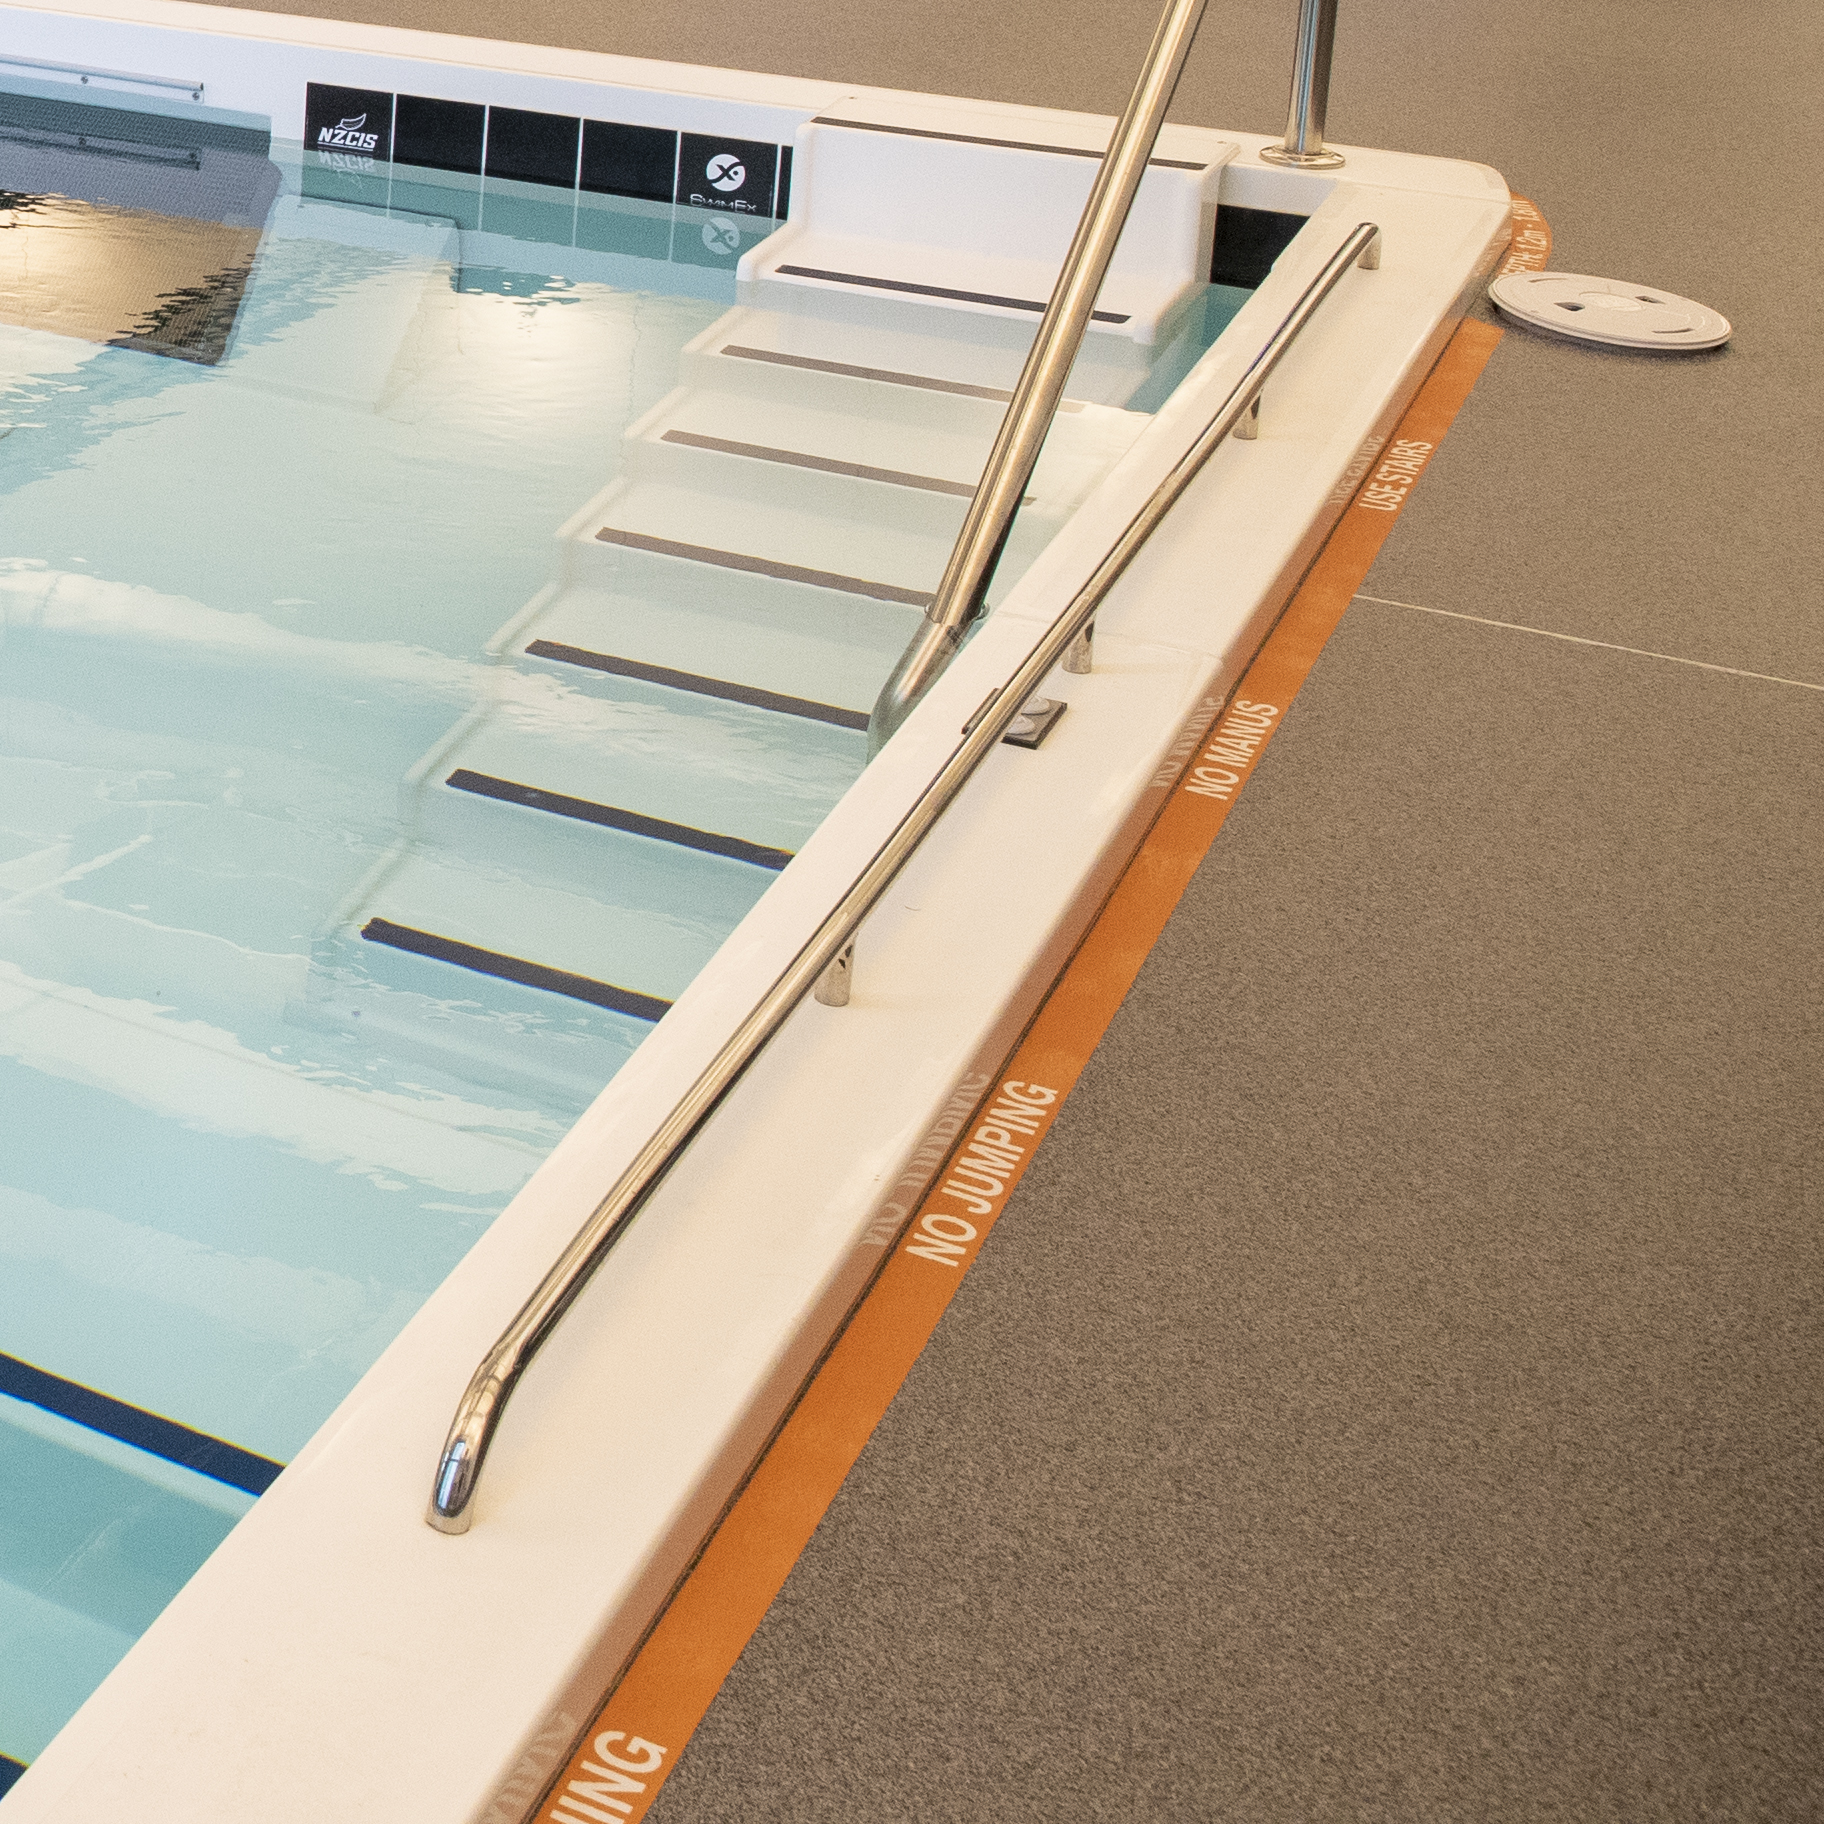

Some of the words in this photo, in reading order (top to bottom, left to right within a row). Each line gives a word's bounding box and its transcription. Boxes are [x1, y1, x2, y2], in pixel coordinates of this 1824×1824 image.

[318, 127, 379, 149] NZCIS
[1498, 251, 1544, 276] EPTH:
[1359, 471, 1406, 512] USE
[1383, 438, 1434, 494] STAIRS
[1184, 753, 1244, 802] NO
[1214, 700, 1279, 773] MANUS
[939, 1078, 1060, 1217] JUMPING
[904, 1213, 979, 1267] NO
